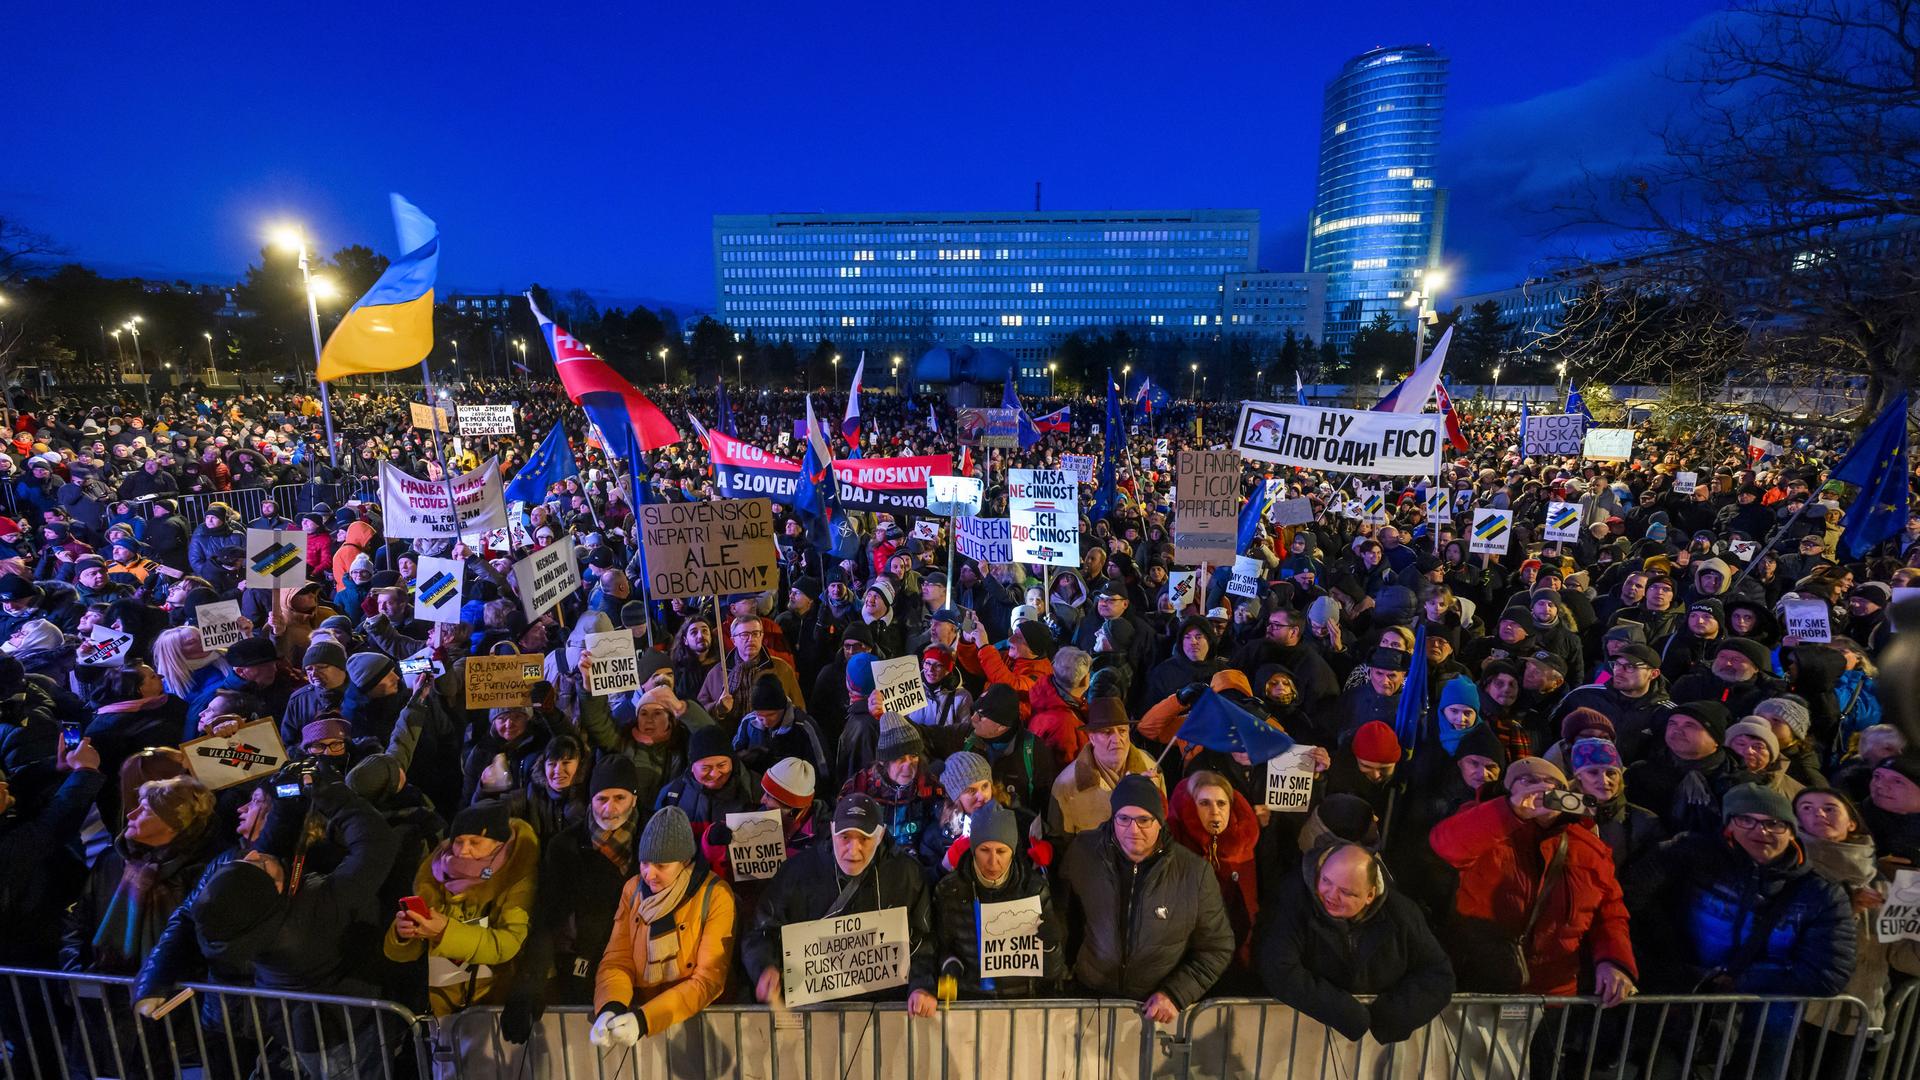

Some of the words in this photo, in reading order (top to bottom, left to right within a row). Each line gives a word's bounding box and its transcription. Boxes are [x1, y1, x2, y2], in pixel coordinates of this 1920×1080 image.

[1318, 412, 1354, 438] НУ
[1526, 426, 1580, 442] RUSKÁ
[727, 441, 768, 464] FICO,
[1284, 432, 1378, 466] ПОГОДИ!
[1382, 429, 1437, 458] FICO
[1526, 442, 1580, 455] ONUCA
[1181, 450, 1240, 474] BLANÁR
[717, 471, 728, 488] A
[732, 473, 798, 496] SLOVEN
[858, 466, 932, 484] MOSKVY
[1033, 470, 1066, 484] NAŠA
[400, 479, 445, 496] HANBA
[1010, 482, 1074, 500] NEČINNOSŤ
[1194, 475, 1239, 497] FICOV
[409, 496, 448, 508] FICOVEJ
[840, 484, 873, 504] DAJ
[878, 493, 924, 508] POKO
[461, 508, 480, 520] JAN
[644, 502, 761, 526] SLOVENSKO
[1176, 497, 1237, 518] PAPAGÁJ
[422, 515, 437, 523] ALL
[1036, 512, 1056, 527] ICH
[648, 524, 710, 546] NEPATRÍ
[1012, 524, 1078, 544] ZLOČINNOSŤ
[684, 544, 740, 568] ALE
[956, 534, 1014, 563] SUTERÉNU
[534, 578, 544, 592] ABY
[656, 565, 768, 594] OBČANOM!
[1228, 581, 1256, 595] EURÓPA
[1242, 575, 1257, 585] SME
[202, 625, 217, 636] MY
[220, 622, 239, 633] SM
[1790, 619, 1804, 628] MY
[1805, 619, 1826, 628] SME
[204, 630, 244, 647] EURÓPA
[592, 661, 608, 675] MY
[611, 658, 634, 672] SME
[594, 672, 637, 690] EURÓPA
[880, 686, 895, 701] MY
[898, 678, 921, 694] SME
[884, 691, 924, 712] EURÓPA
[209, 749, 265, 764] VLASTIZRADA
[1270, 774, 1287, 789] MY
[1289, 776, 1311, 790] SME
[1269, 790, 1307, 806] EURÓPA
[733, 846, 751, 860] MY
[756, 842, 783, 858] SME
[1884, 904, 1912, 917] MY
[835, 917, 861, 934] FICO
[985, 938, 1006, 953] MY
[1010, 935, 1040, 950] SME
[805, 952, 845, 976] RUSKÝ
[985, 951, 1039, 971] EURÓPA
